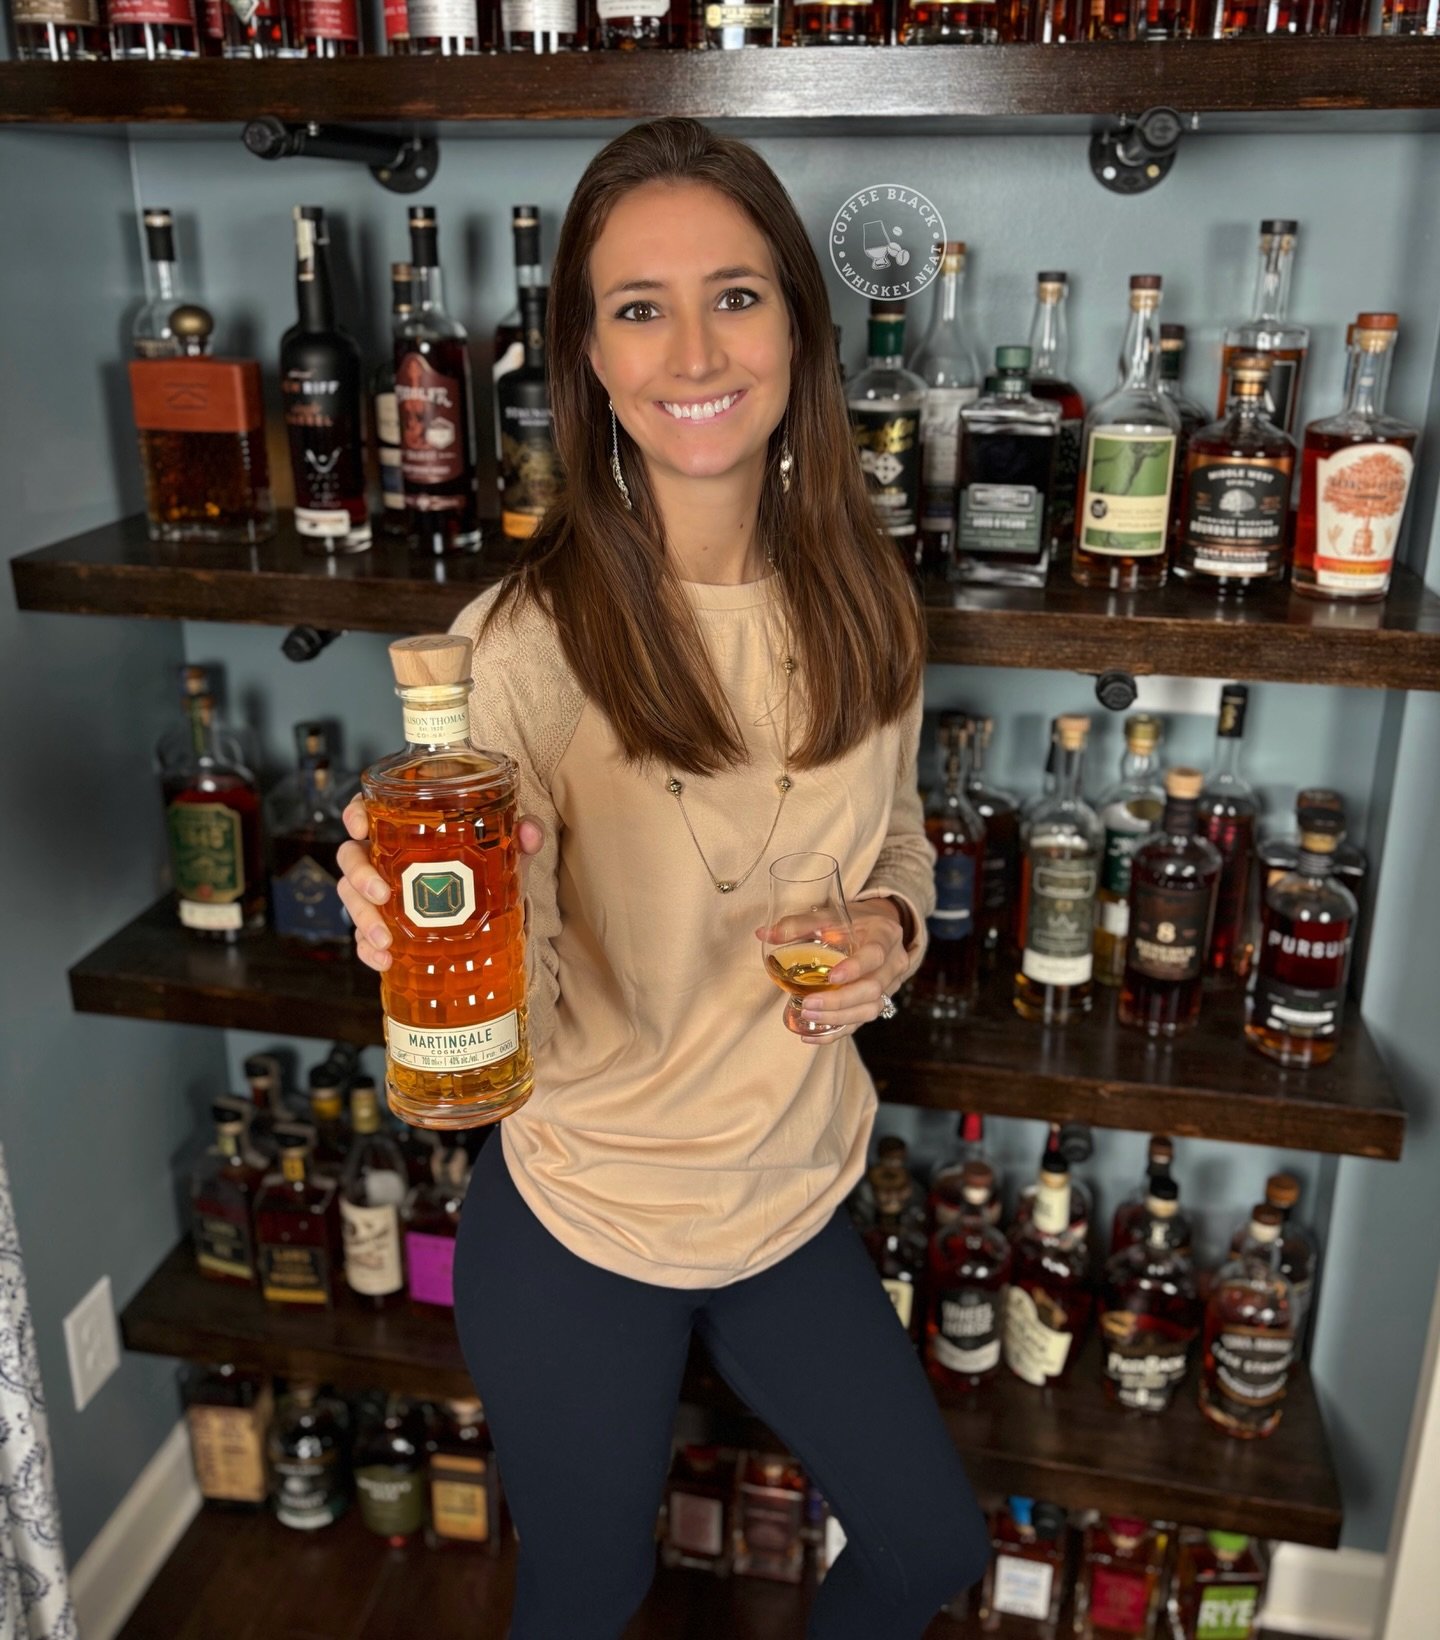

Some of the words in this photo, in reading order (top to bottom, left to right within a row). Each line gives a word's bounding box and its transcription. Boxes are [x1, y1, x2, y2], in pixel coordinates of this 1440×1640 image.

[429, 713, 466, 726] THOMAS
[408, 1028, 493, 1049] MARTINGALE
[1199, 1598, 1257, 1629] RYE
